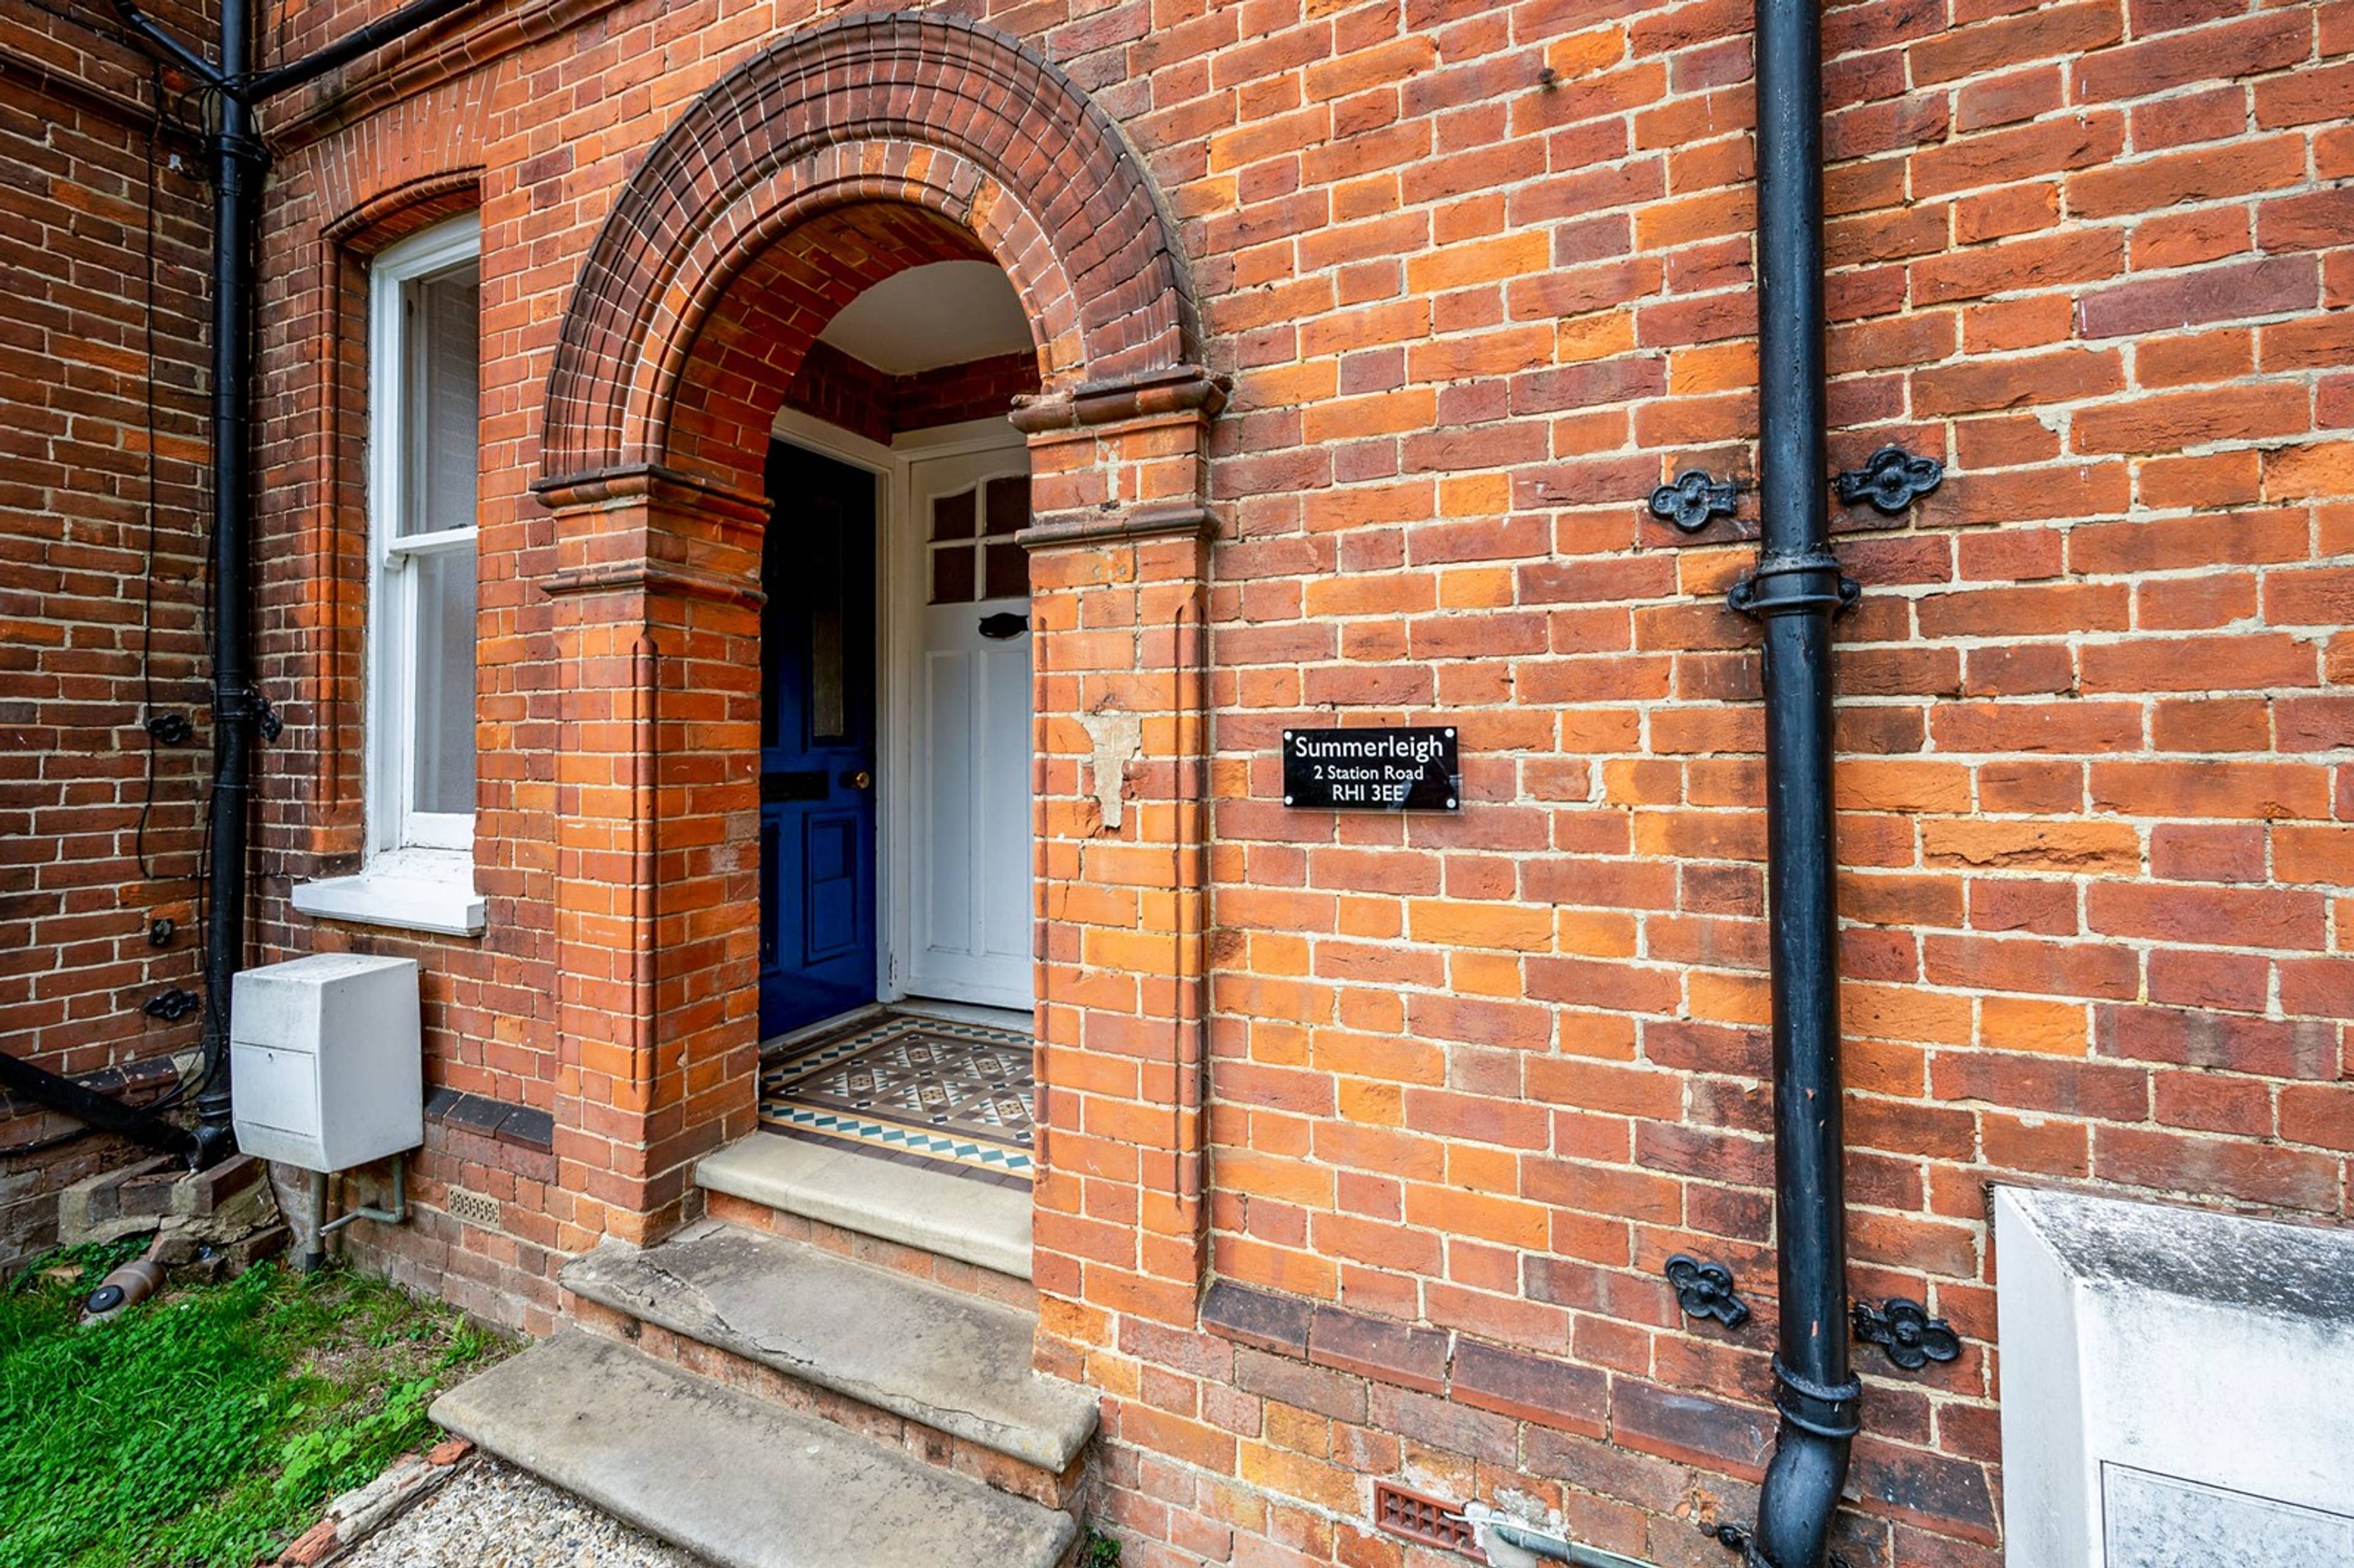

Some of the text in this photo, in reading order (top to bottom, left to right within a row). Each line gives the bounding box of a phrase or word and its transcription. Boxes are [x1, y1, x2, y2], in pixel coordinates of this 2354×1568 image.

[1295, 736, 1443, 763] Summerleigh
[1314, 766, 1424, 780] 2 Station Road
[1371, 785, 1404, 801] 3EE
